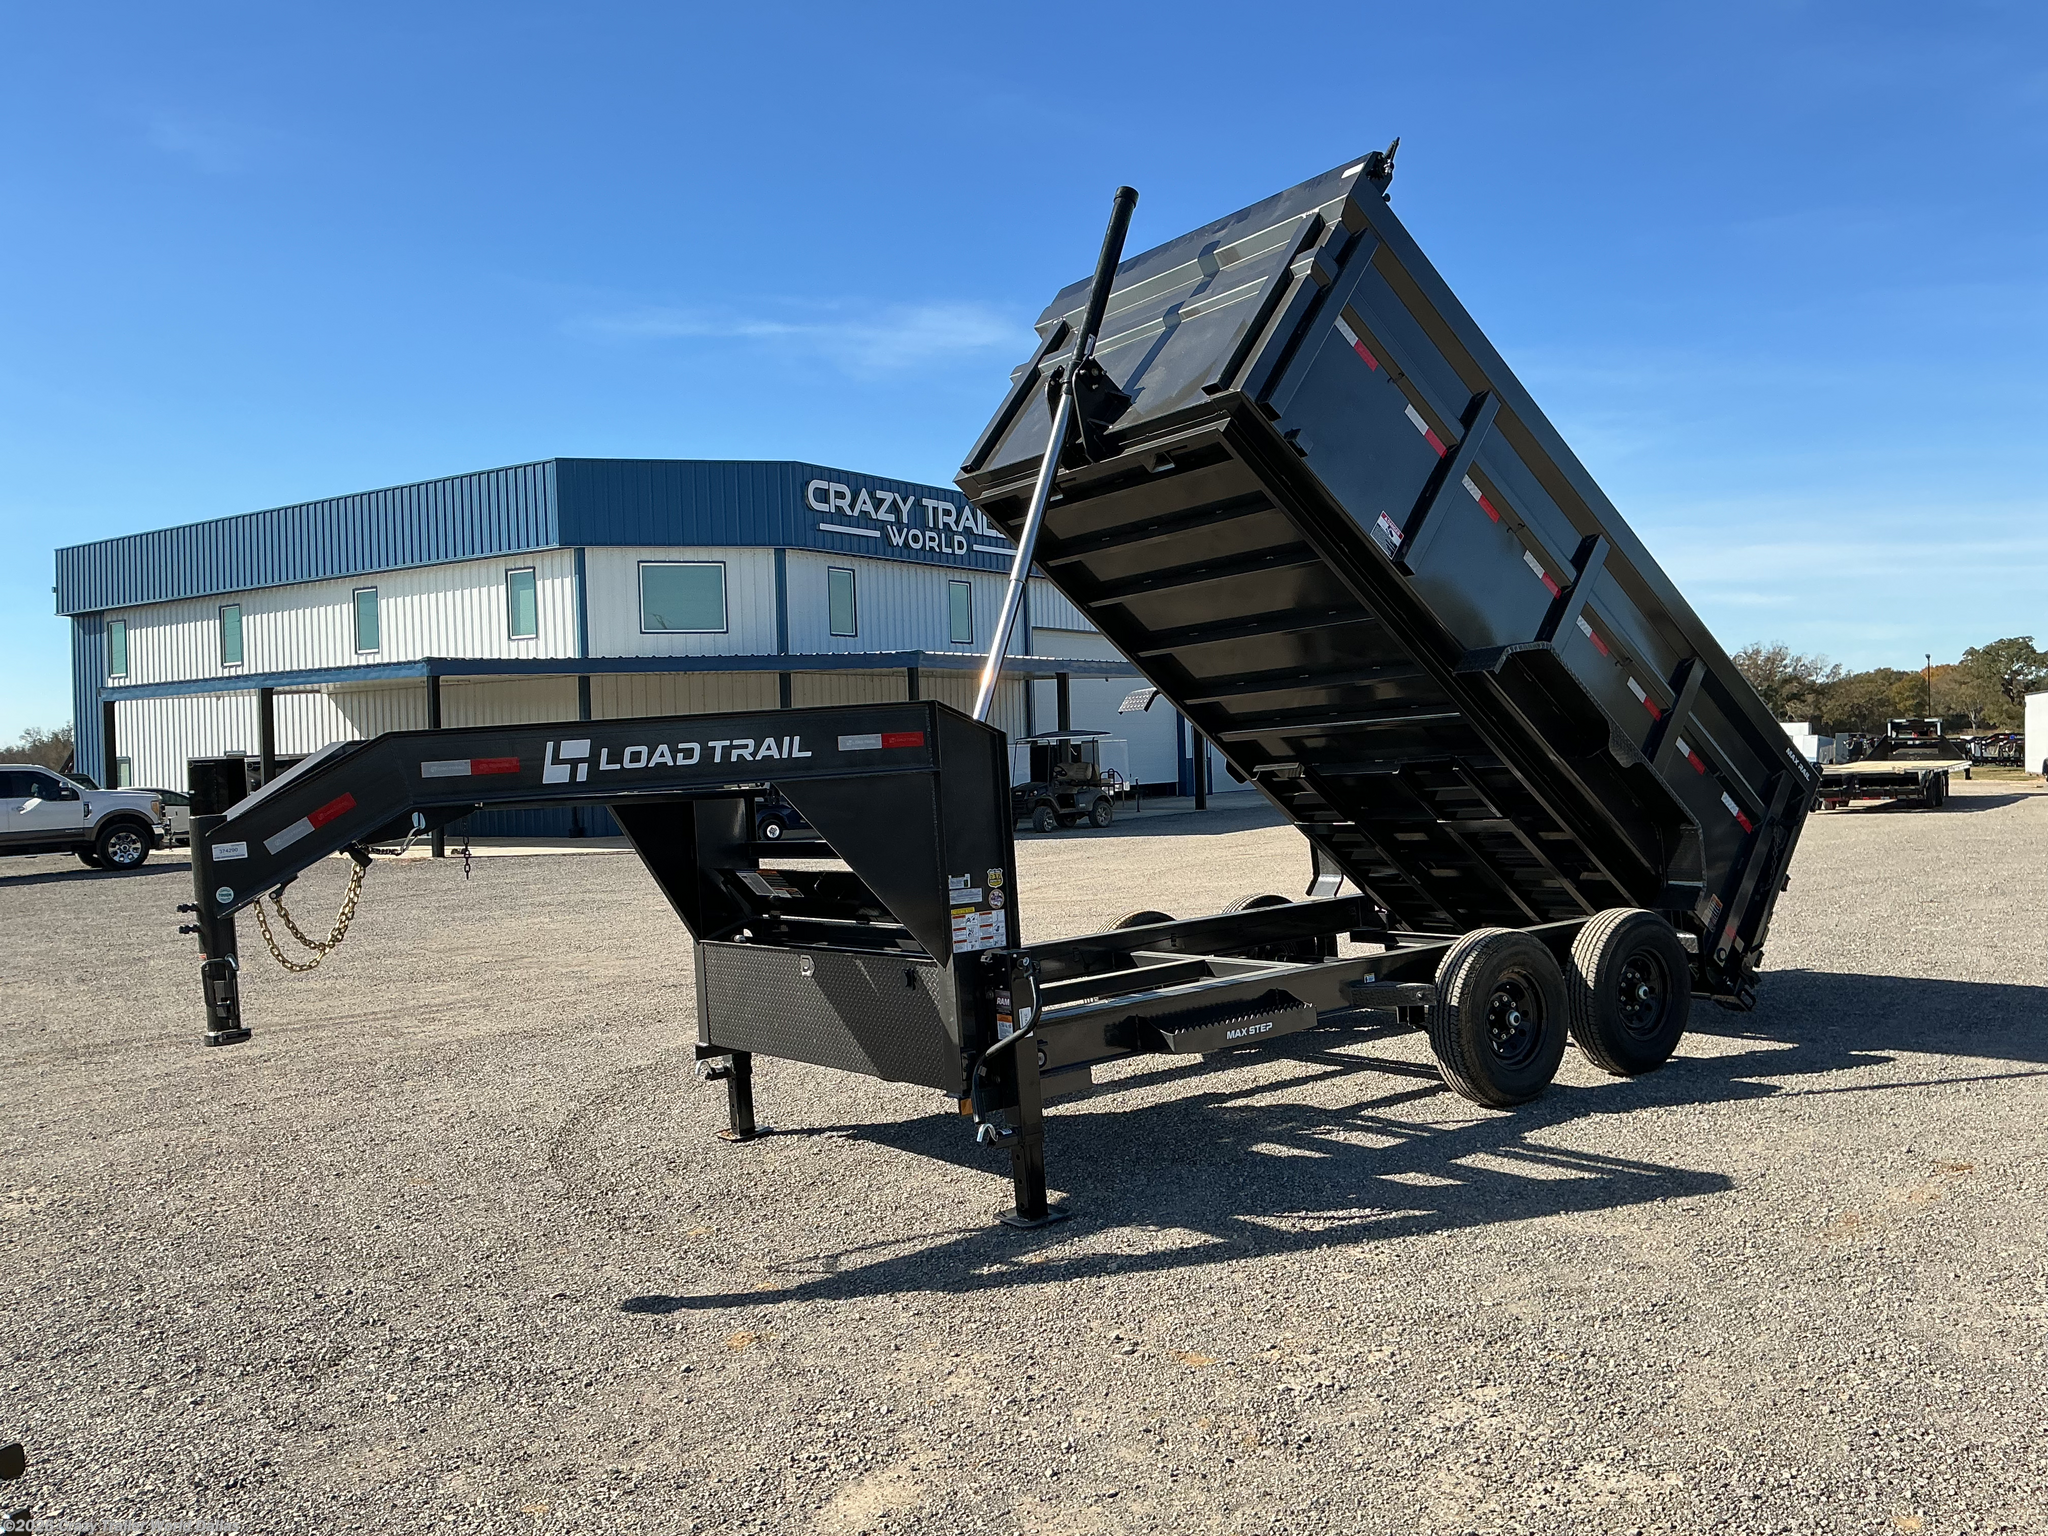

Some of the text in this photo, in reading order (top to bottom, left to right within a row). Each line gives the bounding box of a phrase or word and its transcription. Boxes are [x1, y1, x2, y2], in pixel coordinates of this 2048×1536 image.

[807, 479, 1007, 538] CRAZY TRAIL
[887, 525, 967, 555] WORLD
[599, 742, 701, 771] LOAD
[707, 735, 812, 763] TRAIL
[1786, 748, 1810, 782] MAX RAIL
[996, 997, 1010, 1006] RAM
[1226, 1022, 1273, 1039] MAX STEP
